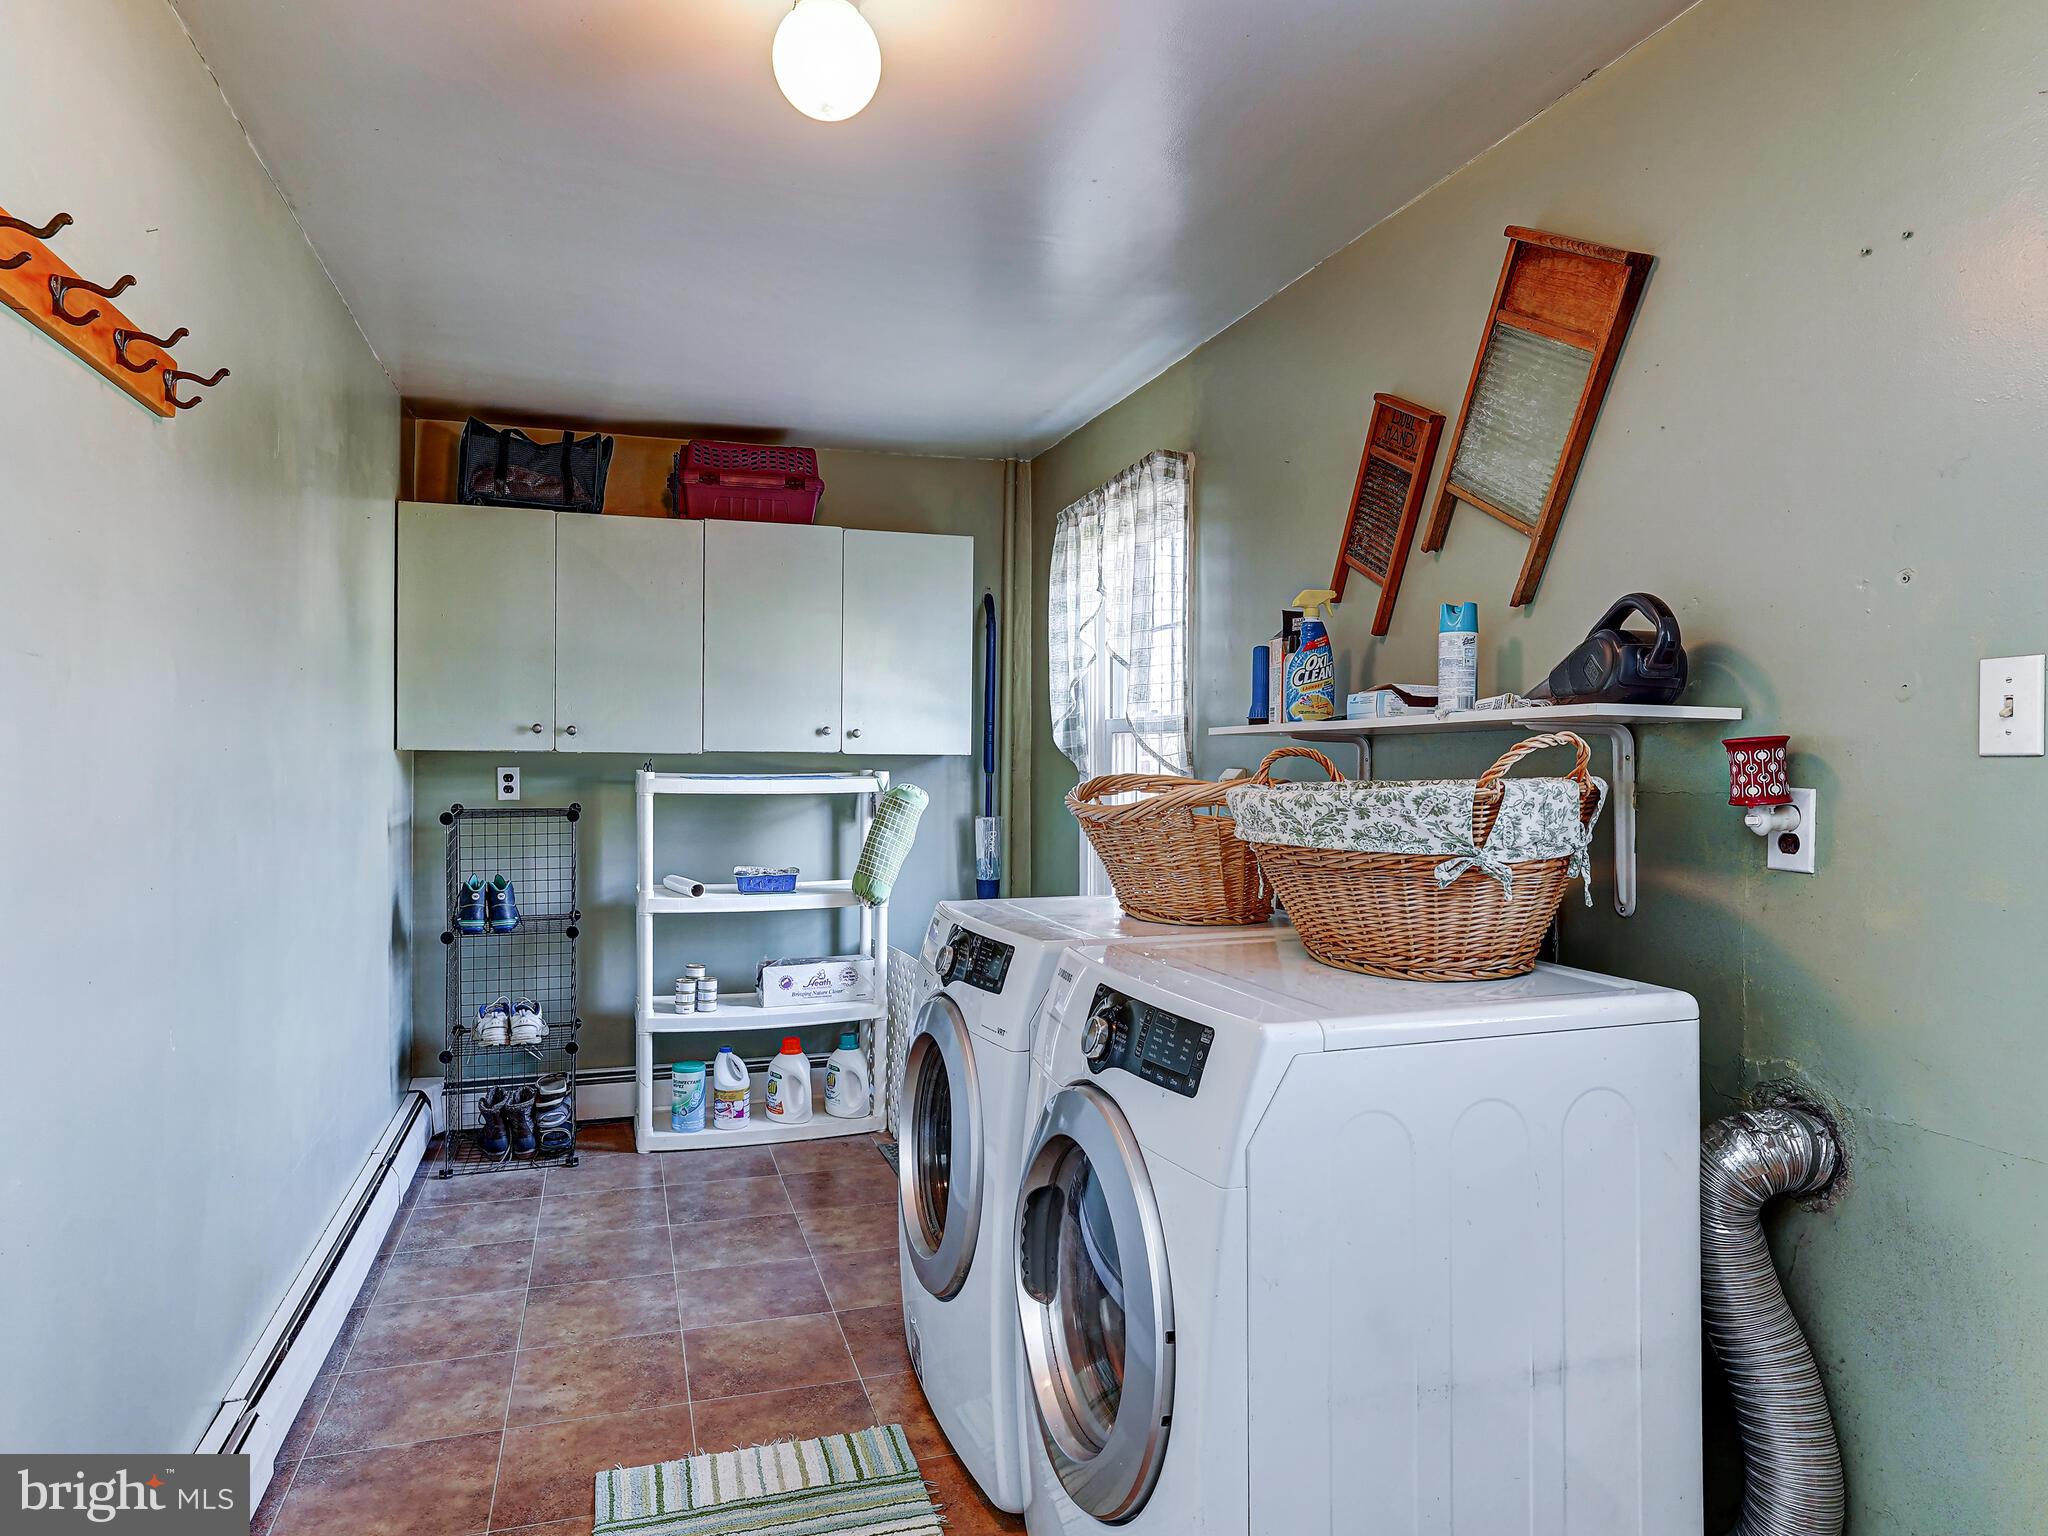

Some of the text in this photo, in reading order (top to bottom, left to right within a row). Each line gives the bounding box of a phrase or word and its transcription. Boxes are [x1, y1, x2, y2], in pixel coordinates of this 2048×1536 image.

[1385, 424, 1417, 449] HANDI
[1305, 654, 1328, 671] OXI
[1292, 664, 1334, 688] CLEAN
[803, 975, 832, 989] Heath
